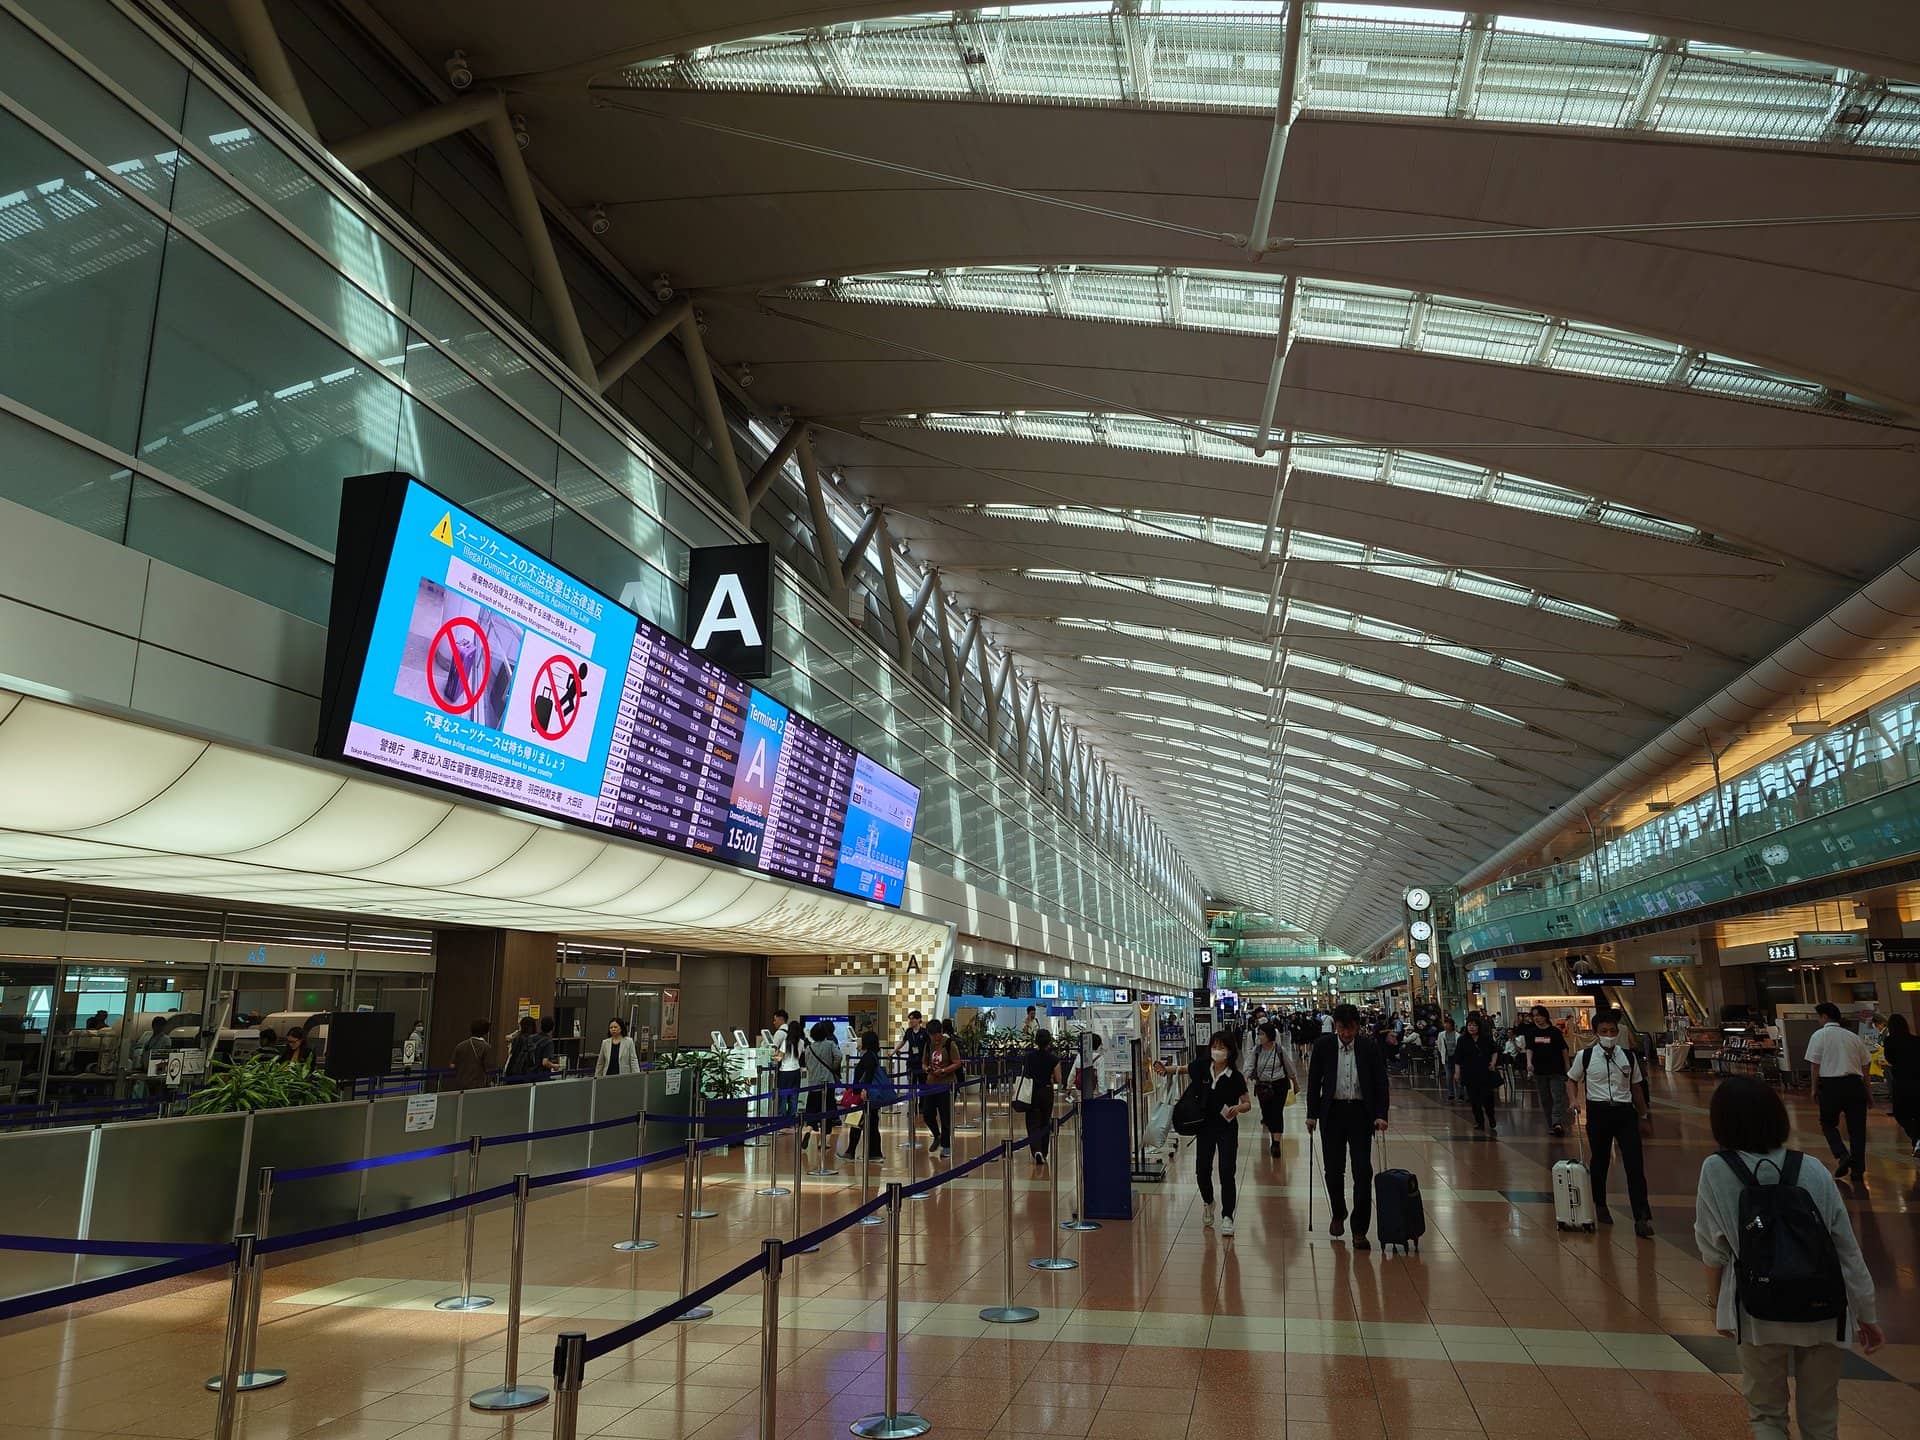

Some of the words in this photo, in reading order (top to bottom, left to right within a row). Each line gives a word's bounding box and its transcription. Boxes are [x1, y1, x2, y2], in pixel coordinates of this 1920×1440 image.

[455, 520, 603, 618] スーツケースの不法投棄は法律違反
[462, 544, 483, 565] Illegal
[482, 556, 510, 580] Dumping
[511, 572, 518, 582] of
[691, 573, 763, 649] A
[748, 703, 778, 732] Terminal
[777, 719, 784, 735] 2
[422, 710, 566, 771] 不要なスーツケースは持ち帰りましょう
[434, 732, 452, 745] Please
[378, 737, 406, 757] 警視庁
[566, 794, 583, 809] 大田区
[744, 733, 772, 788] A
[726, 826, 759, 854] 15:01
[1414, 892, 1423, 906] 2
[248, 945, 266, 963] A5
[310, 951, 326, 967] A6
[907, 954, 920, 974] A
[1202, 950, 1212, 963] B
